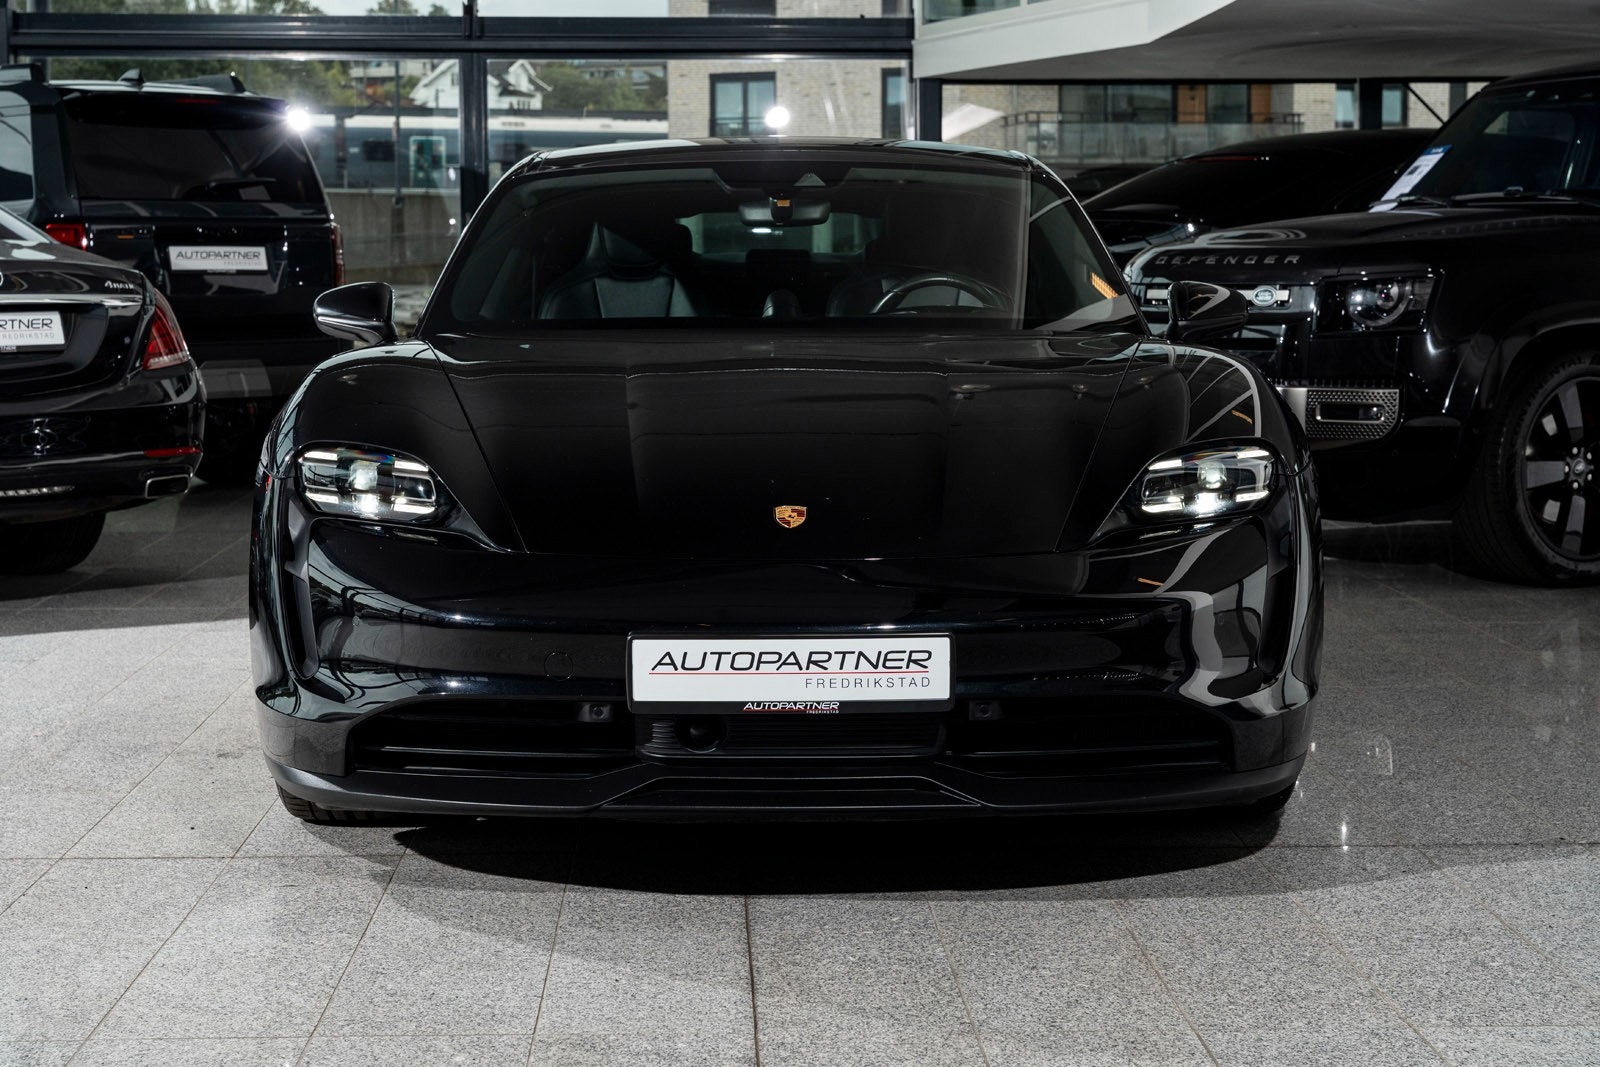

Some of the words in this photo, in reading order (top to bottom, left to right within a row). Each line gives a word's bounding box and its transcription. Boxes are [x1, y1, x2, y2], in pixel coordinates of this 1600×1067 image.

[176, 251, 261, 260] AUTOPARTNER
[1154, 254, 1300, 265] DEFENDER
[0, 331, 55, 340] REDRIKSTAD
[651, 650, 933, 671] AUTOPARTNER
[805, 676, 931, 689] FREDRIKSTAD
[743, 701, 840, 711] AUTOPARTNER
